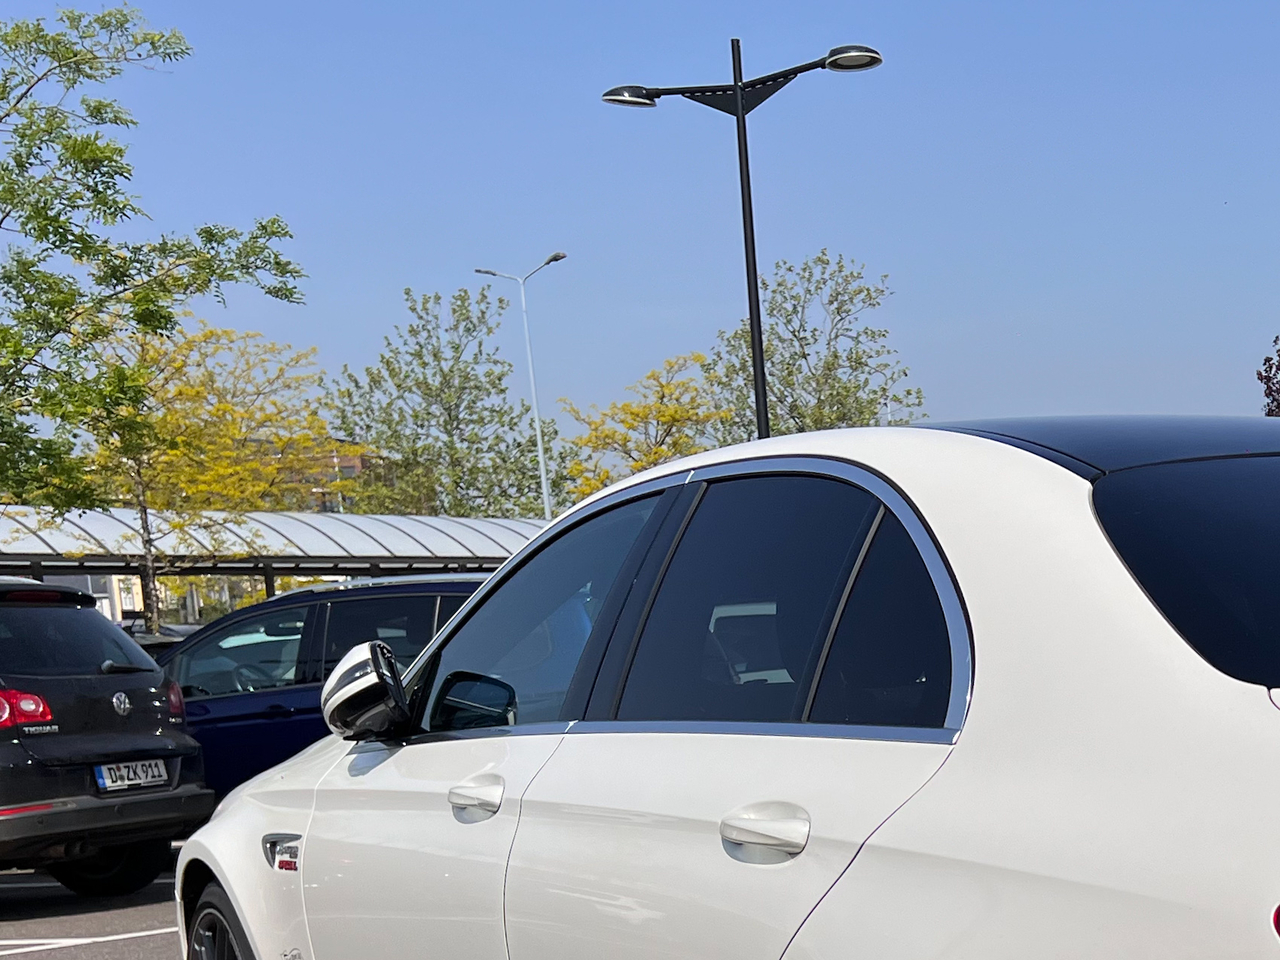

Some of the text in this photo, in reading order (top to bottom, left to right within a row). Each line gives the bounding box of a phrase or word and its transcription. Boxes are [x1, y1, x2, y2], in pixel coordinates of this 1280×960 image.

[107, 761, 163, 784] D ZK 911
